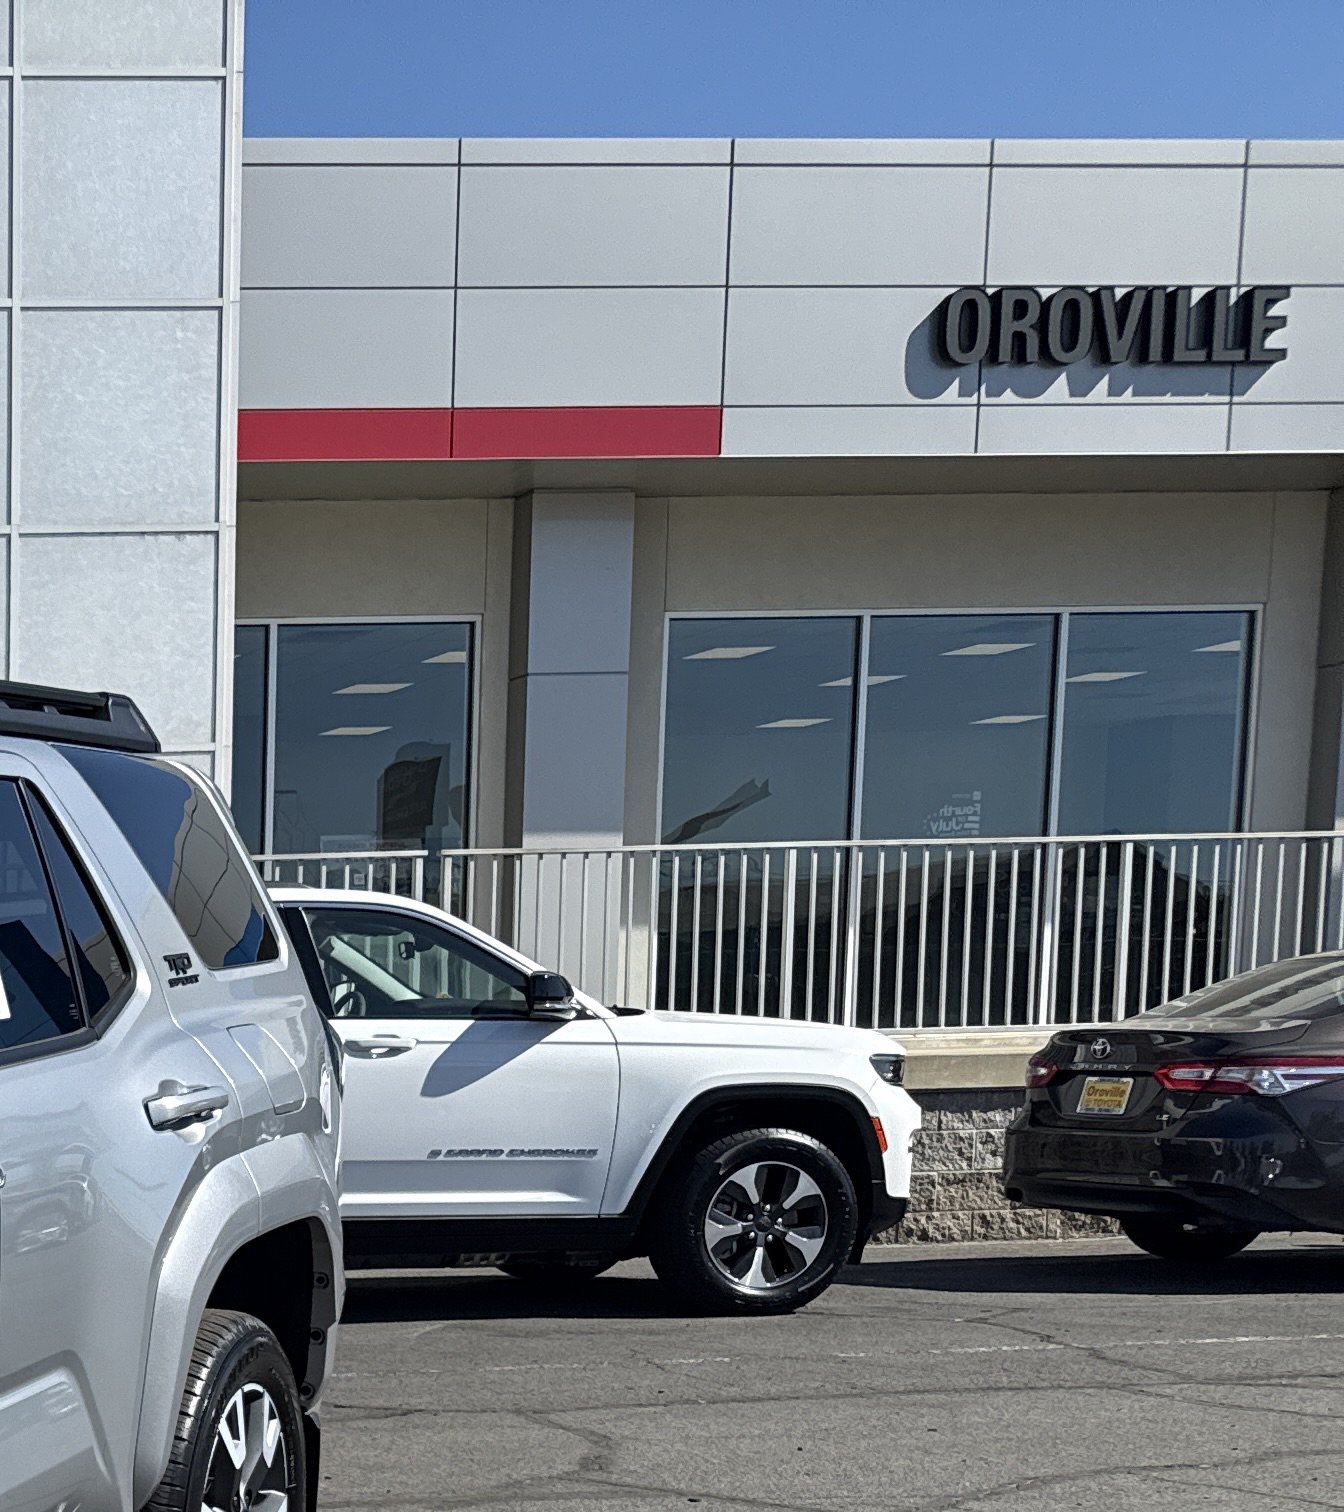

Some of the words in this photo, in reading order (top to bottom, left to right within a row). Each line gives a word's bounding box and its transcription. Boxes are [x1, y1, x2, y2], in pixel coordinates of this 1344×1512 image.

[942, 286, 1291, 364] OROVILLE
[1087, 1085, 1126, 1098] Oroville
[443, 1148, 504, 1158] GRAND
